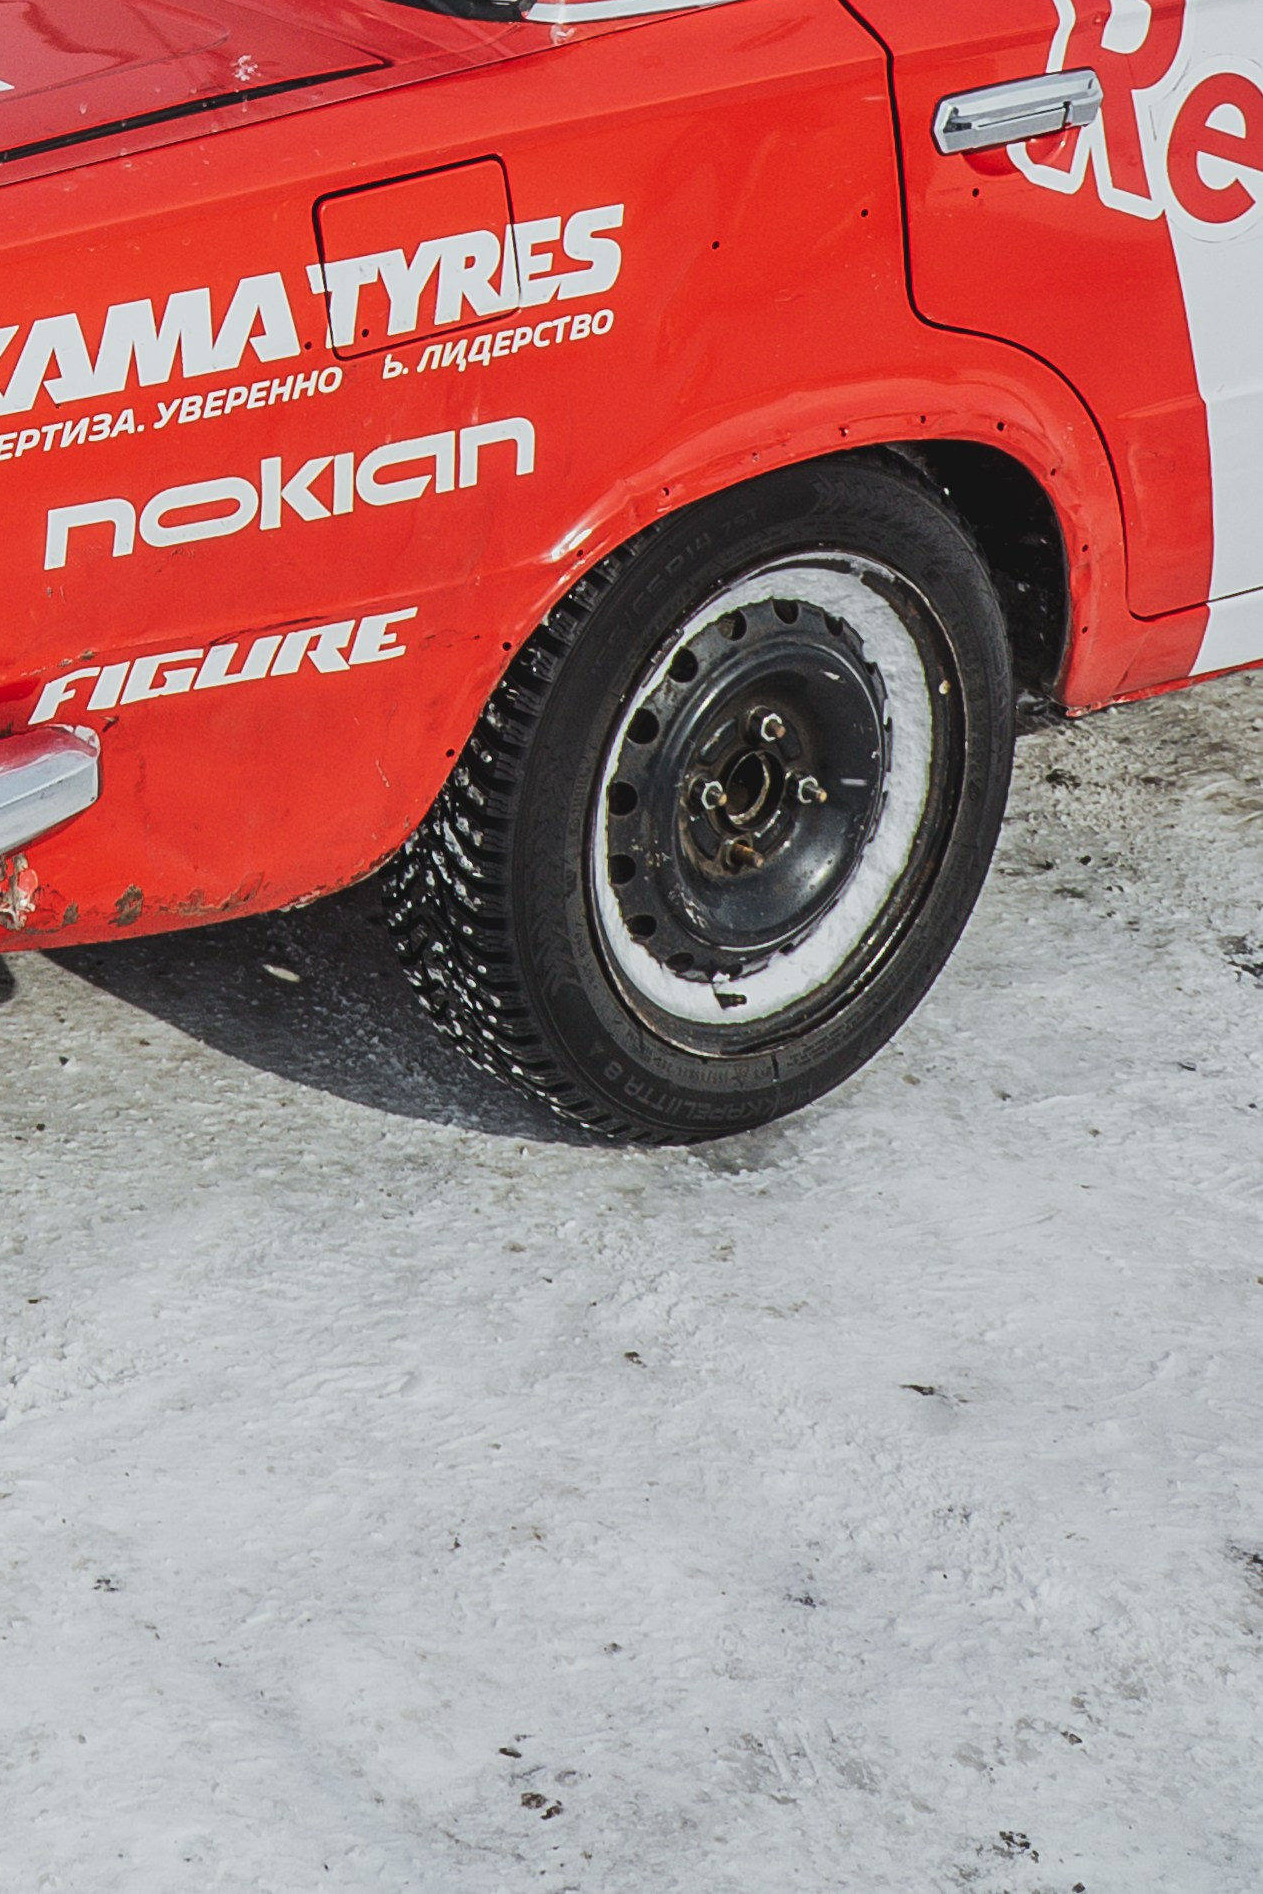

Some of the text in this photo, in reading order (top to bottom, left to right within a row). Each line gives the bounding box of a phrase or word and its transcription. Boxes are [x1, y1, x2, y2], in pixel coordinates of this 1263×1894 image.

[306, 203, 625, 349] TYRES
[416, 309, 614, 373] ЛИДЕРСТВО
[27, 607, 419, 726] FIGURE
